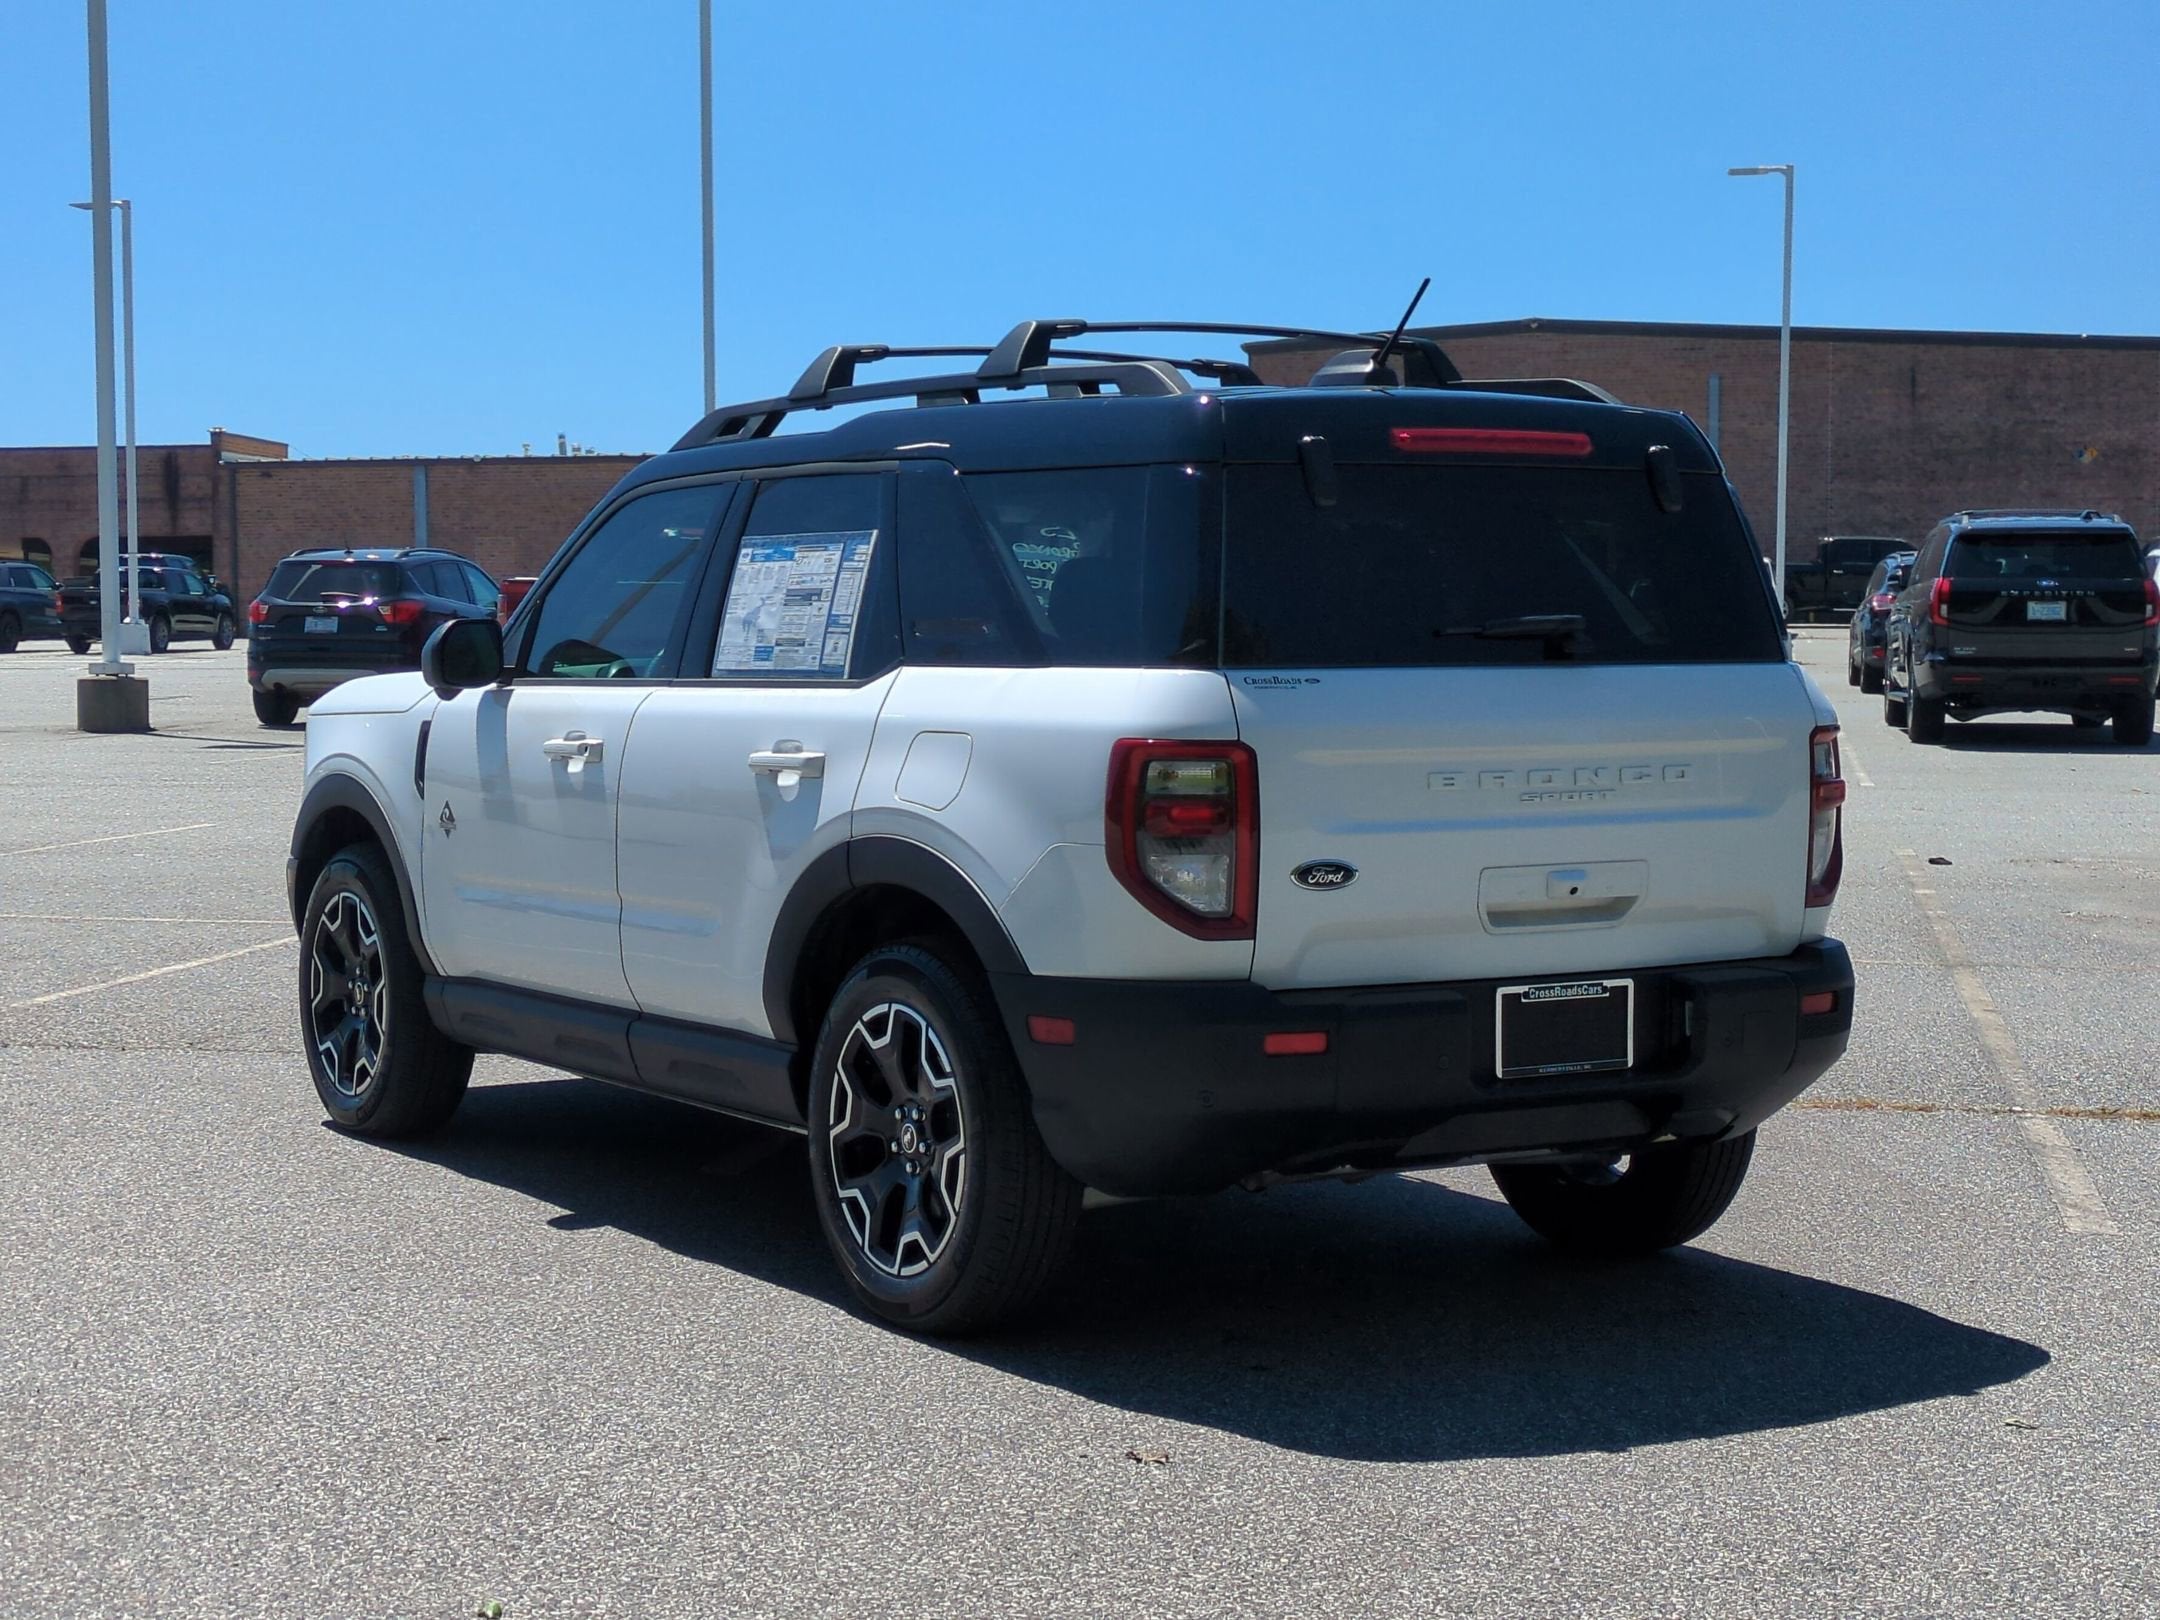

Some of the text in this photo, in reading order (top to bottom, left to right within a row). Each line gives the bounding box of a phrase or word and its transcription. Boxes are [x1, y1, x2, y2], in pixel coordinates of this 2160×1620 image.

[1427, 763, 1693, 790] BRONCO
[1519, 789, 1616, 802] SPORT
[1307, 866, 1345, 884] Ford
[1528, 984, 1603, 999] CrossRoadsCars
